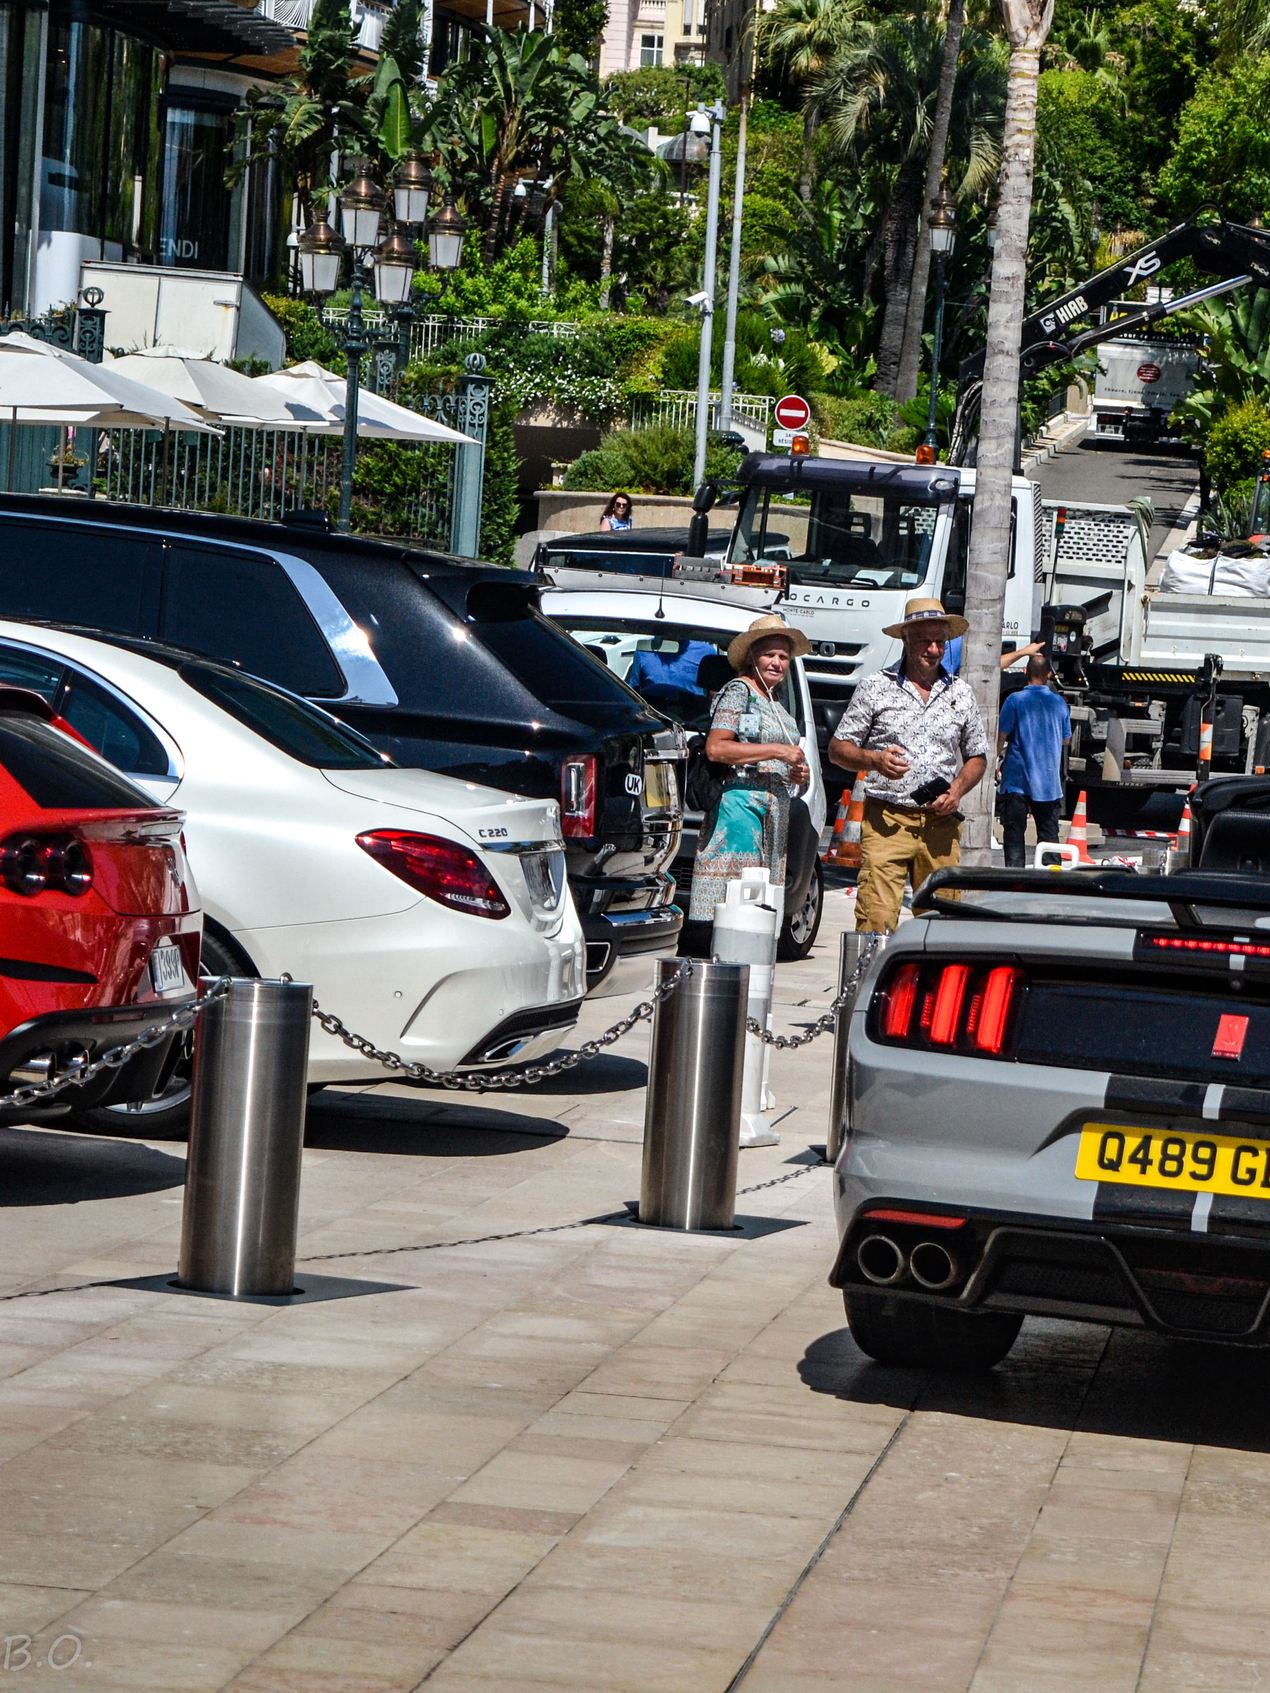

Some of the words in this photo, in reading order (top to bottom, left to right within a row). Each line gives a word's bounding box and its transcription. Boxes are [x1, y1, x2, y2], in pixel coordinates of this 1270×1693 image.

[1123, 250, 1161, 287] XS
[1055, 296, 1089, 324] HIAB
[626, 775, 640, 794] UK
[478, 829, 488, 838] C
[487, 827, 509, 838] 220
[1096, 1130, 1218, 1182] Q489
